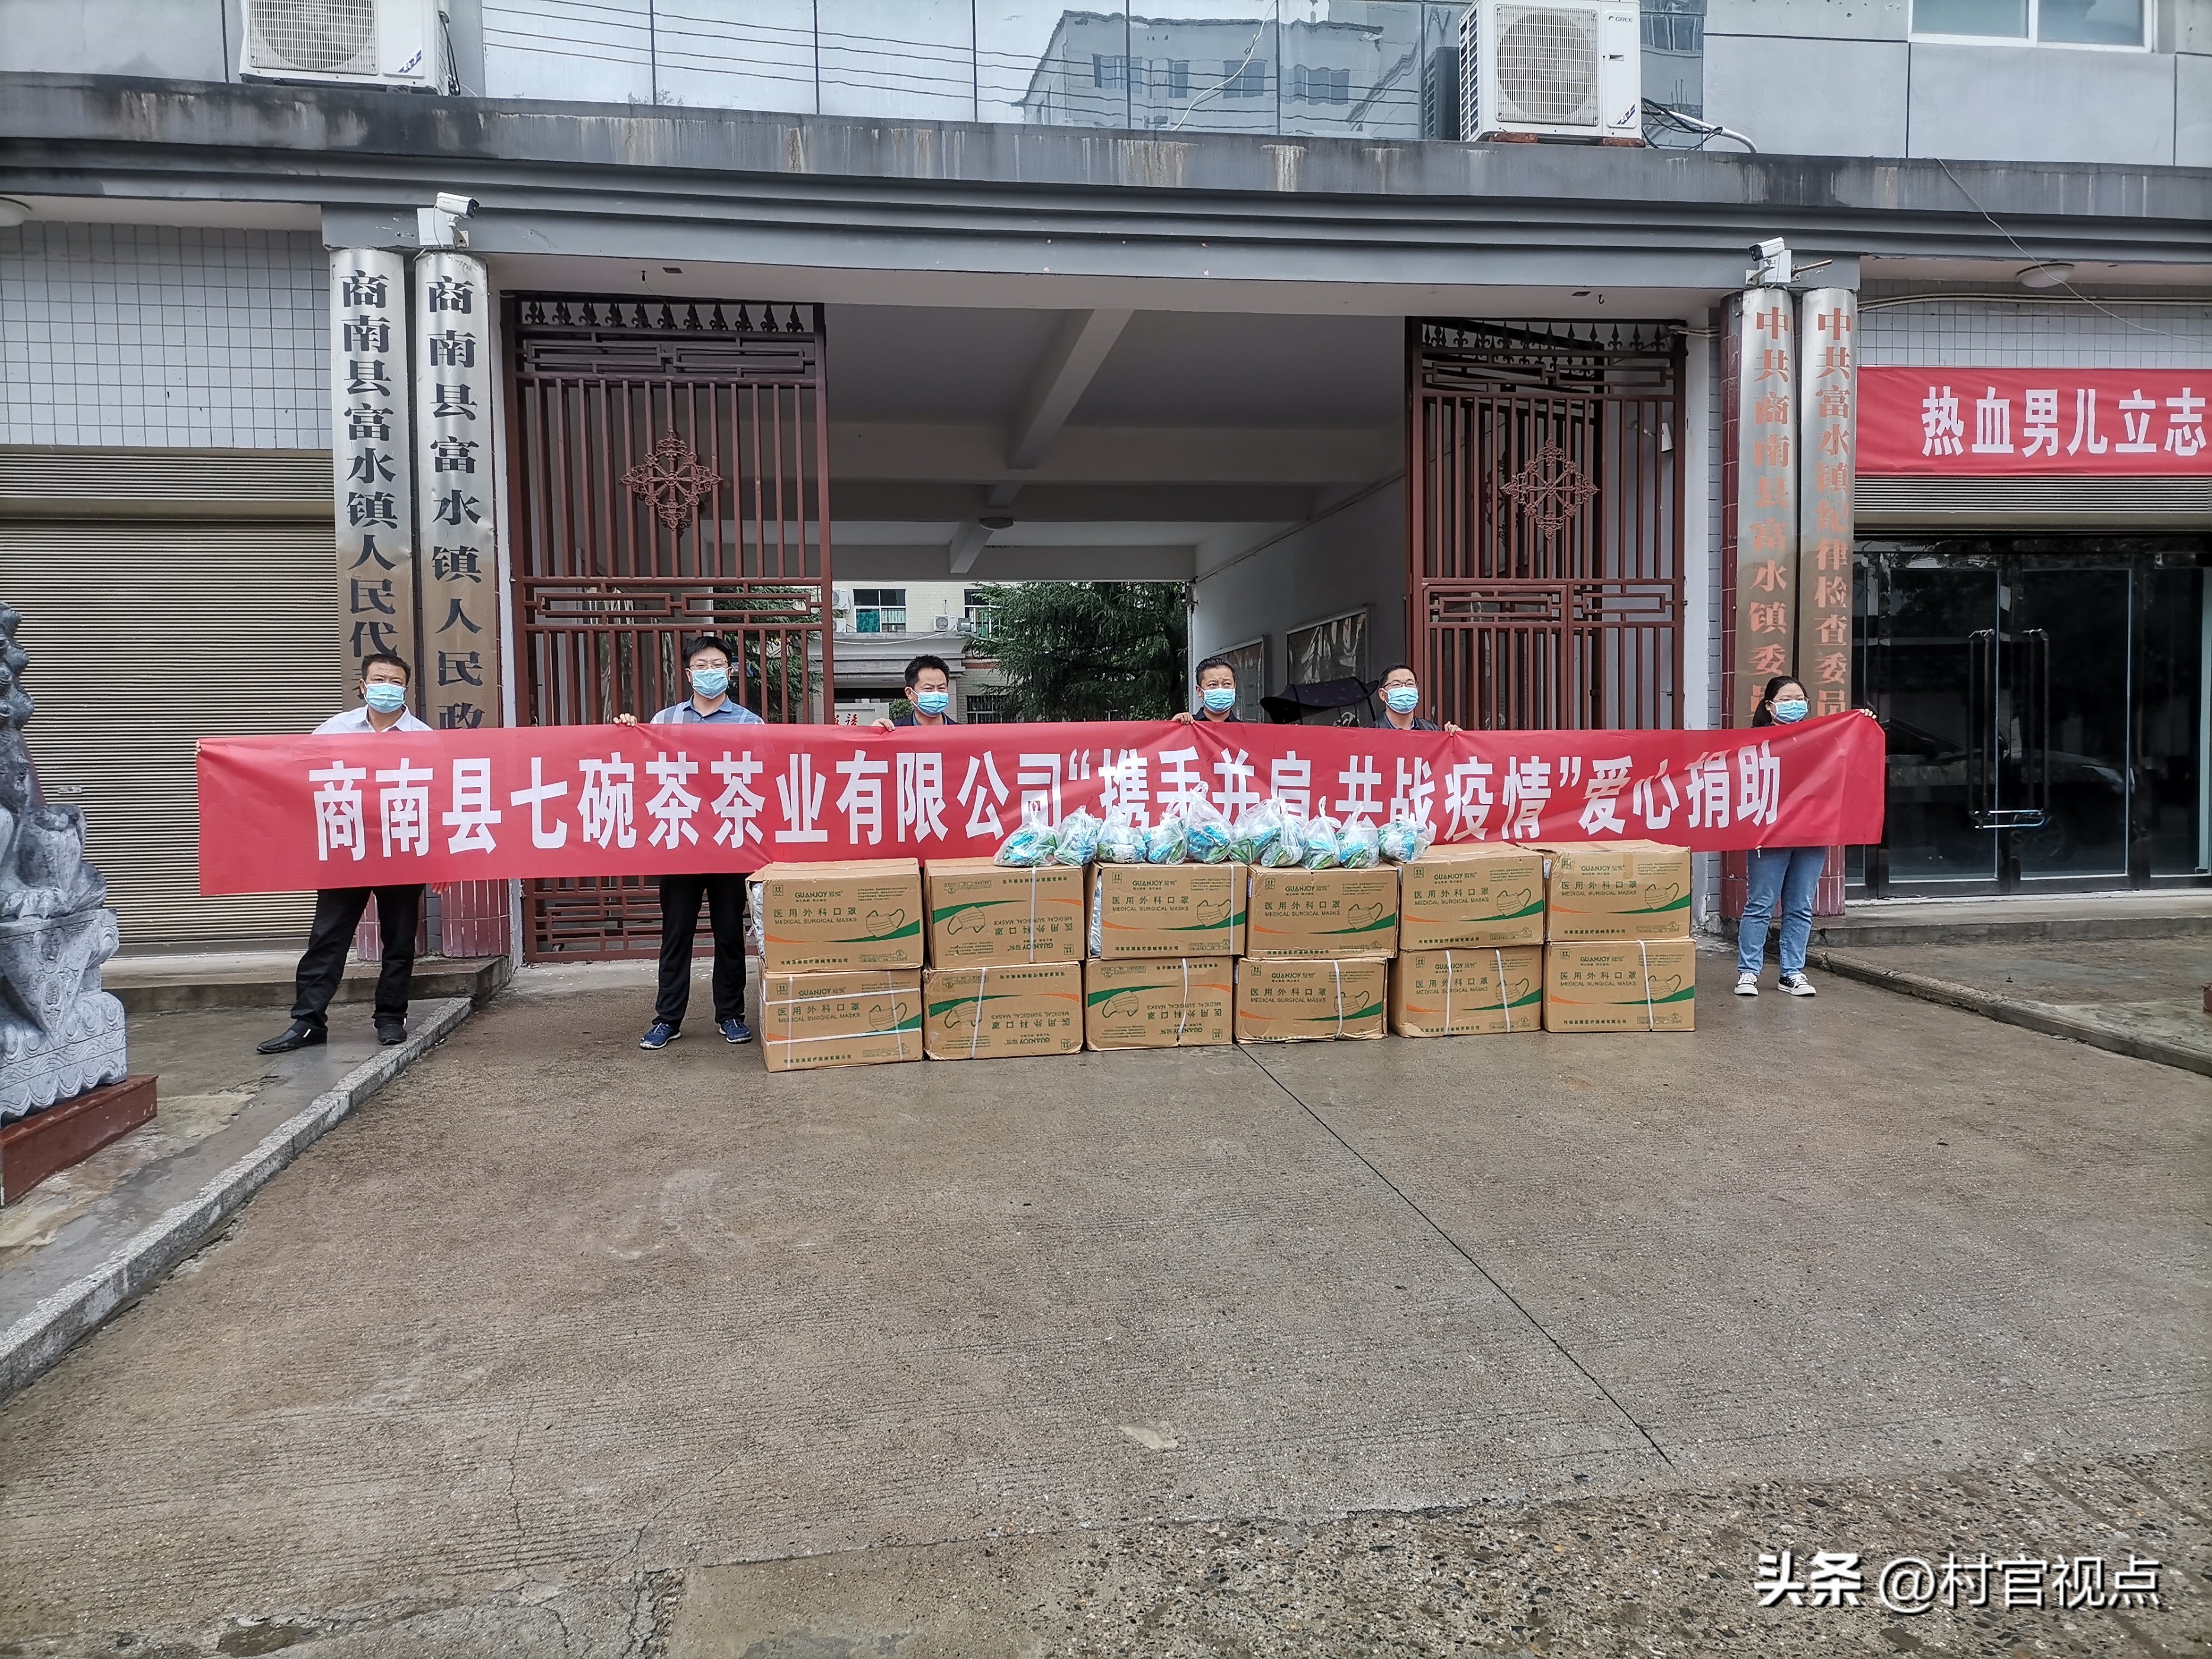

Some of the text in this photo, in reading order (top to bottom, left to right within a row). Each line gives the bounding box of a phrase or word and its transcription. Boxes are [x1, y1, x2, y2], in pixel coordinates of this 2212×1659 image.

[1921, 386, 2207, 457] 热血男儿立志
[425, 275, 485, 729] 商南县富水镇人民政
[1814, 307, 1852, 717] 中共富水镇纪律检查委员
[1562, 881, 1637, 889] 医用外科口罩
[1415, 887, 1488, 899] 医用外科口罩
[1112, 896, 1189, 905] 医用外科口罩
[1265, 900, 1340, 909] 医用外科口罩
[774, 907, 856, 918] 医用外科口罩
[995, 923, 1072, 935] 医用外科口罩
[1561, 971, 1636, 980] 医用外科口罩
[1251, 988, 1326, 996] 医用外科口罩
[778, 1003, 860, 1016] 医用外科口罩
[1148, 1009, 1221, 1020] 医用外科口罩
[992, 1018, 1070, 1029] 医用外科口罩
